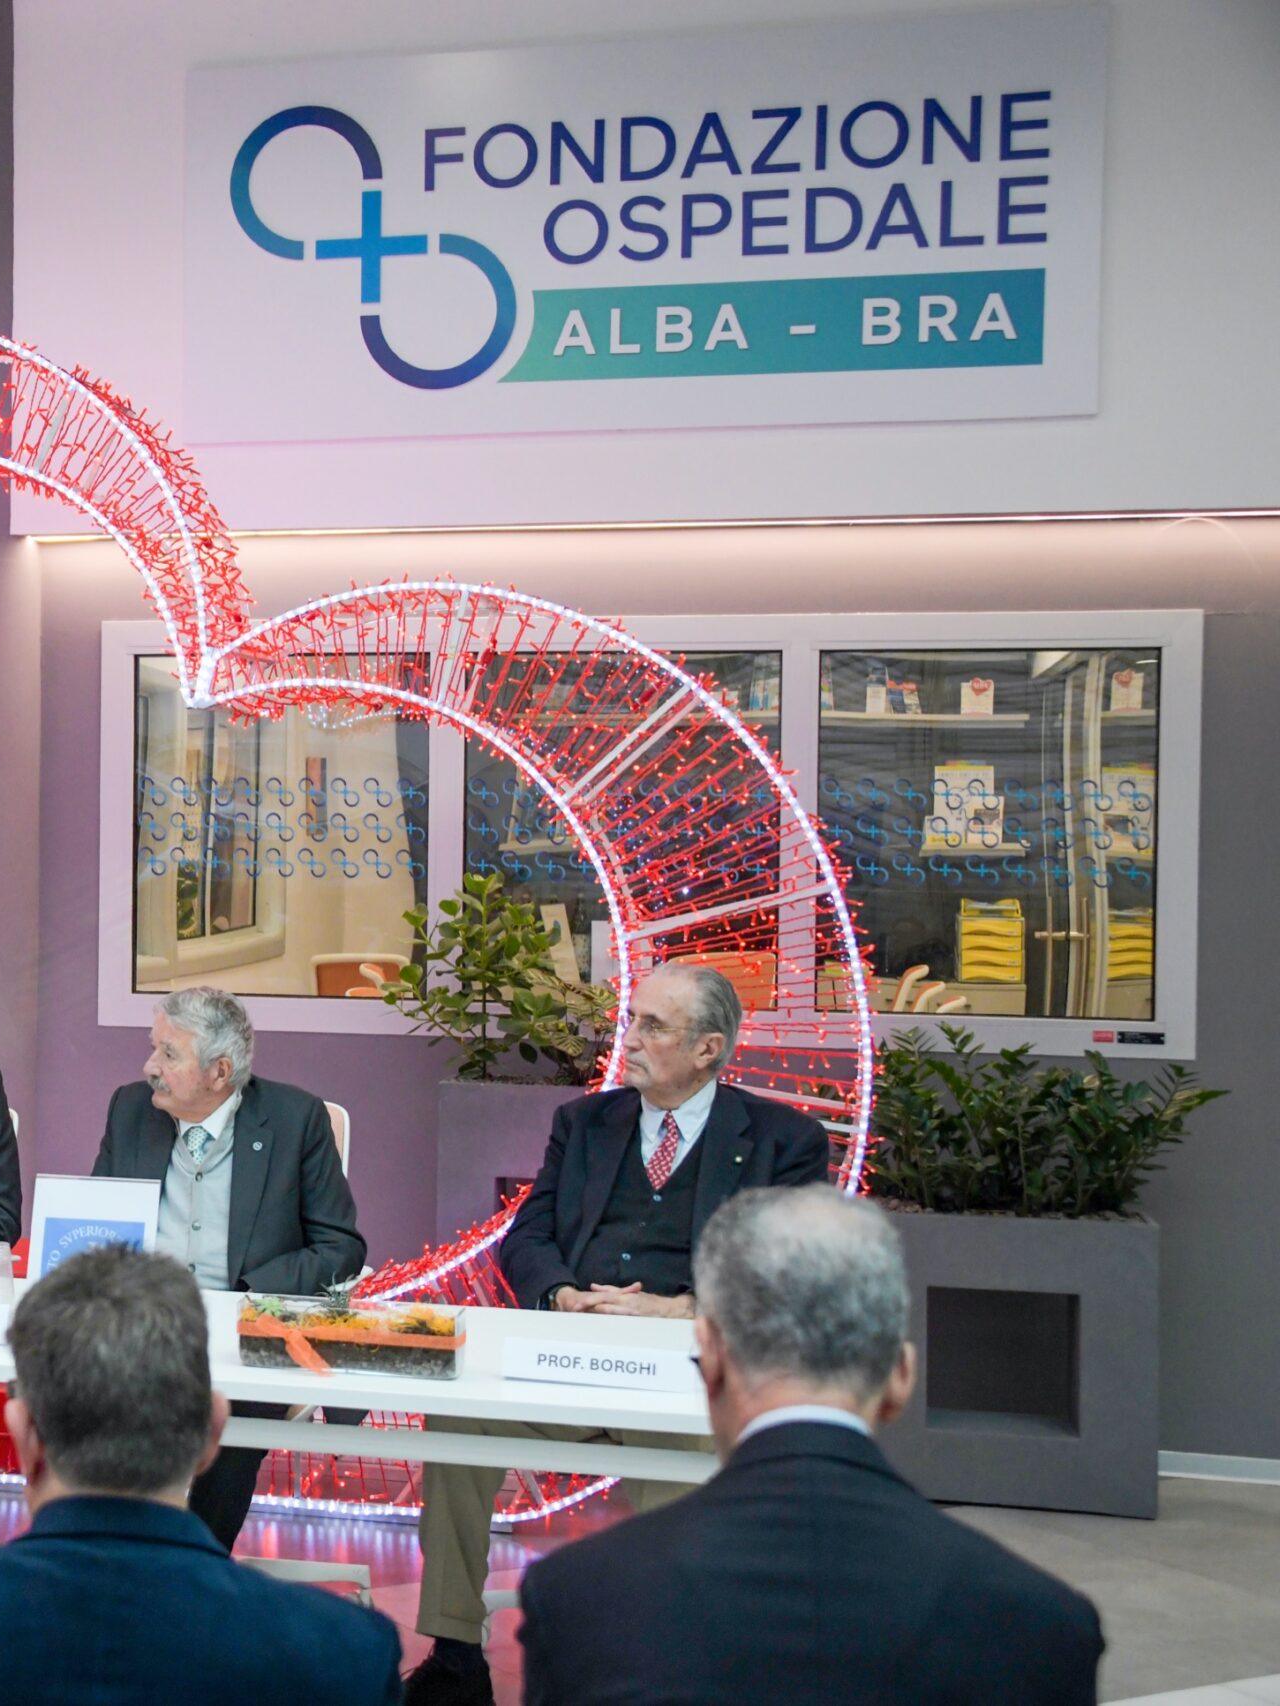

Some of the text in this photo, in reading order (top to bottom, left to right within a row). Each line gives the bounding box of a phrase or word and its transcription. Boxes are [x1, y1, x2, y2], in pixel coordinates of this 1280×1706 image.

[424, 89, 1053, 193] FONDAZIONE
[542, 175, 1050, 266] OSPEDALE
[551, 302, 751, 357] ALBA
[859, 291, 1021, 348] BRA
[537, 1353, 657, 1375] PROF. BORGHI
